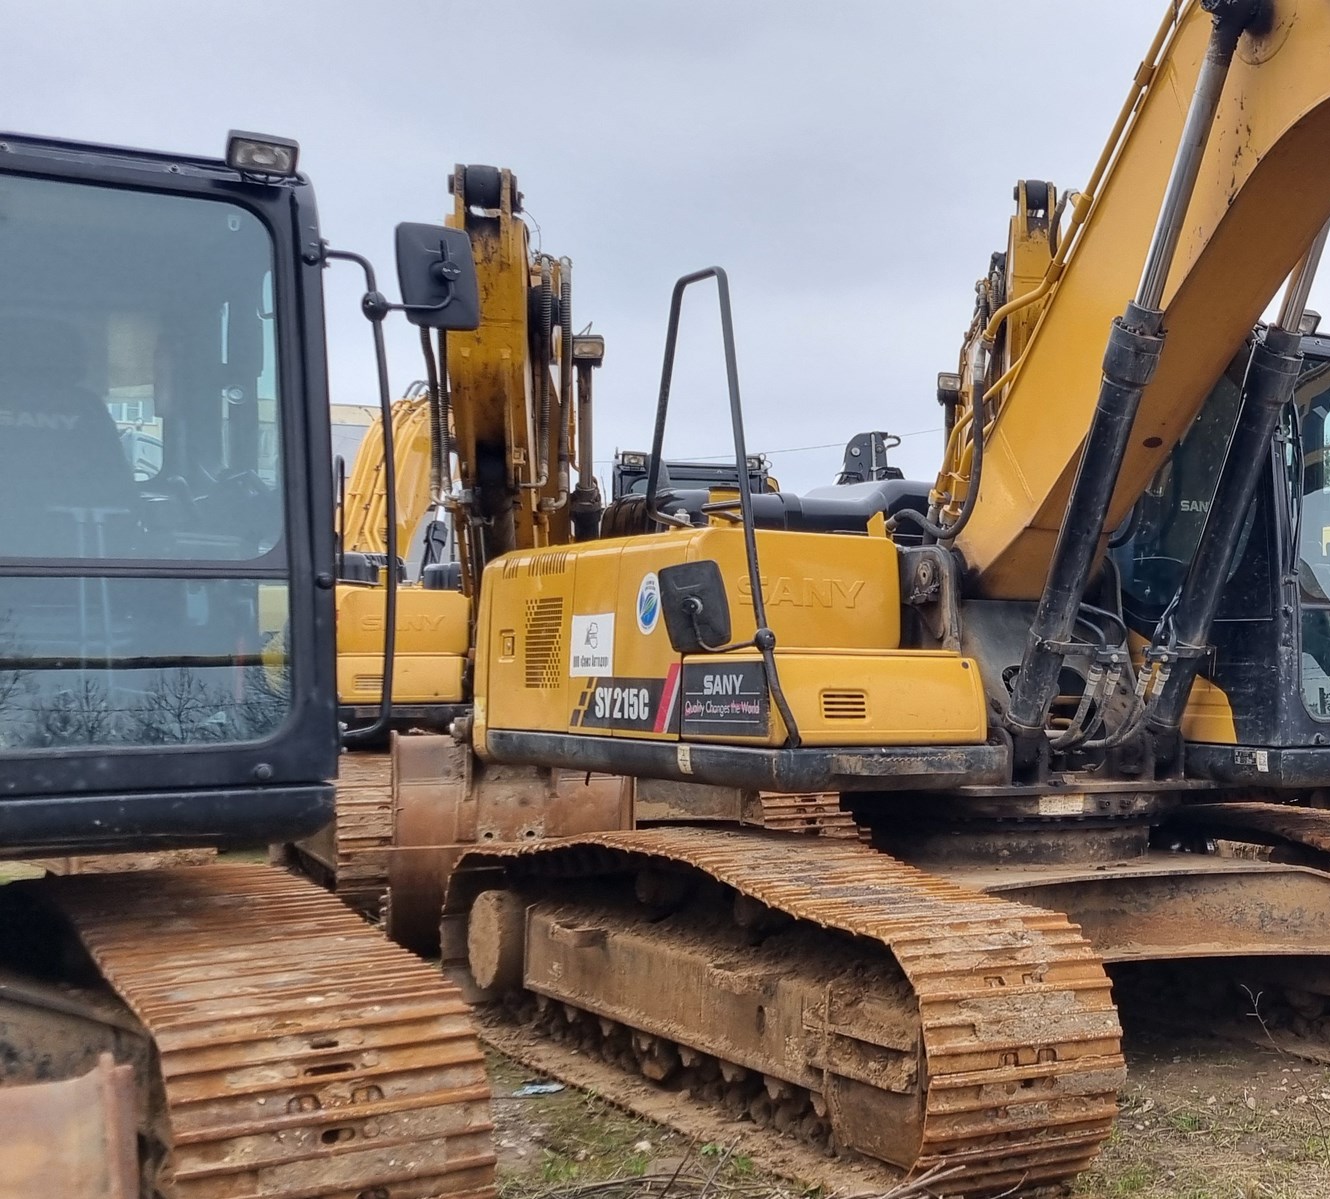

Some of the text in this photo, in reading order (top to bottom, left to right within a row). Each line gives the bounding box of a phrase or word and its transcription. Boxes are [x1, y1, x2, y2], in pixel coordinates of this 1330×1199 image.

[737, 575, 865, 609] SANY
[703, 674, 744, 695] SANY
[684, 699, 760, 717] Quality Changes the World
